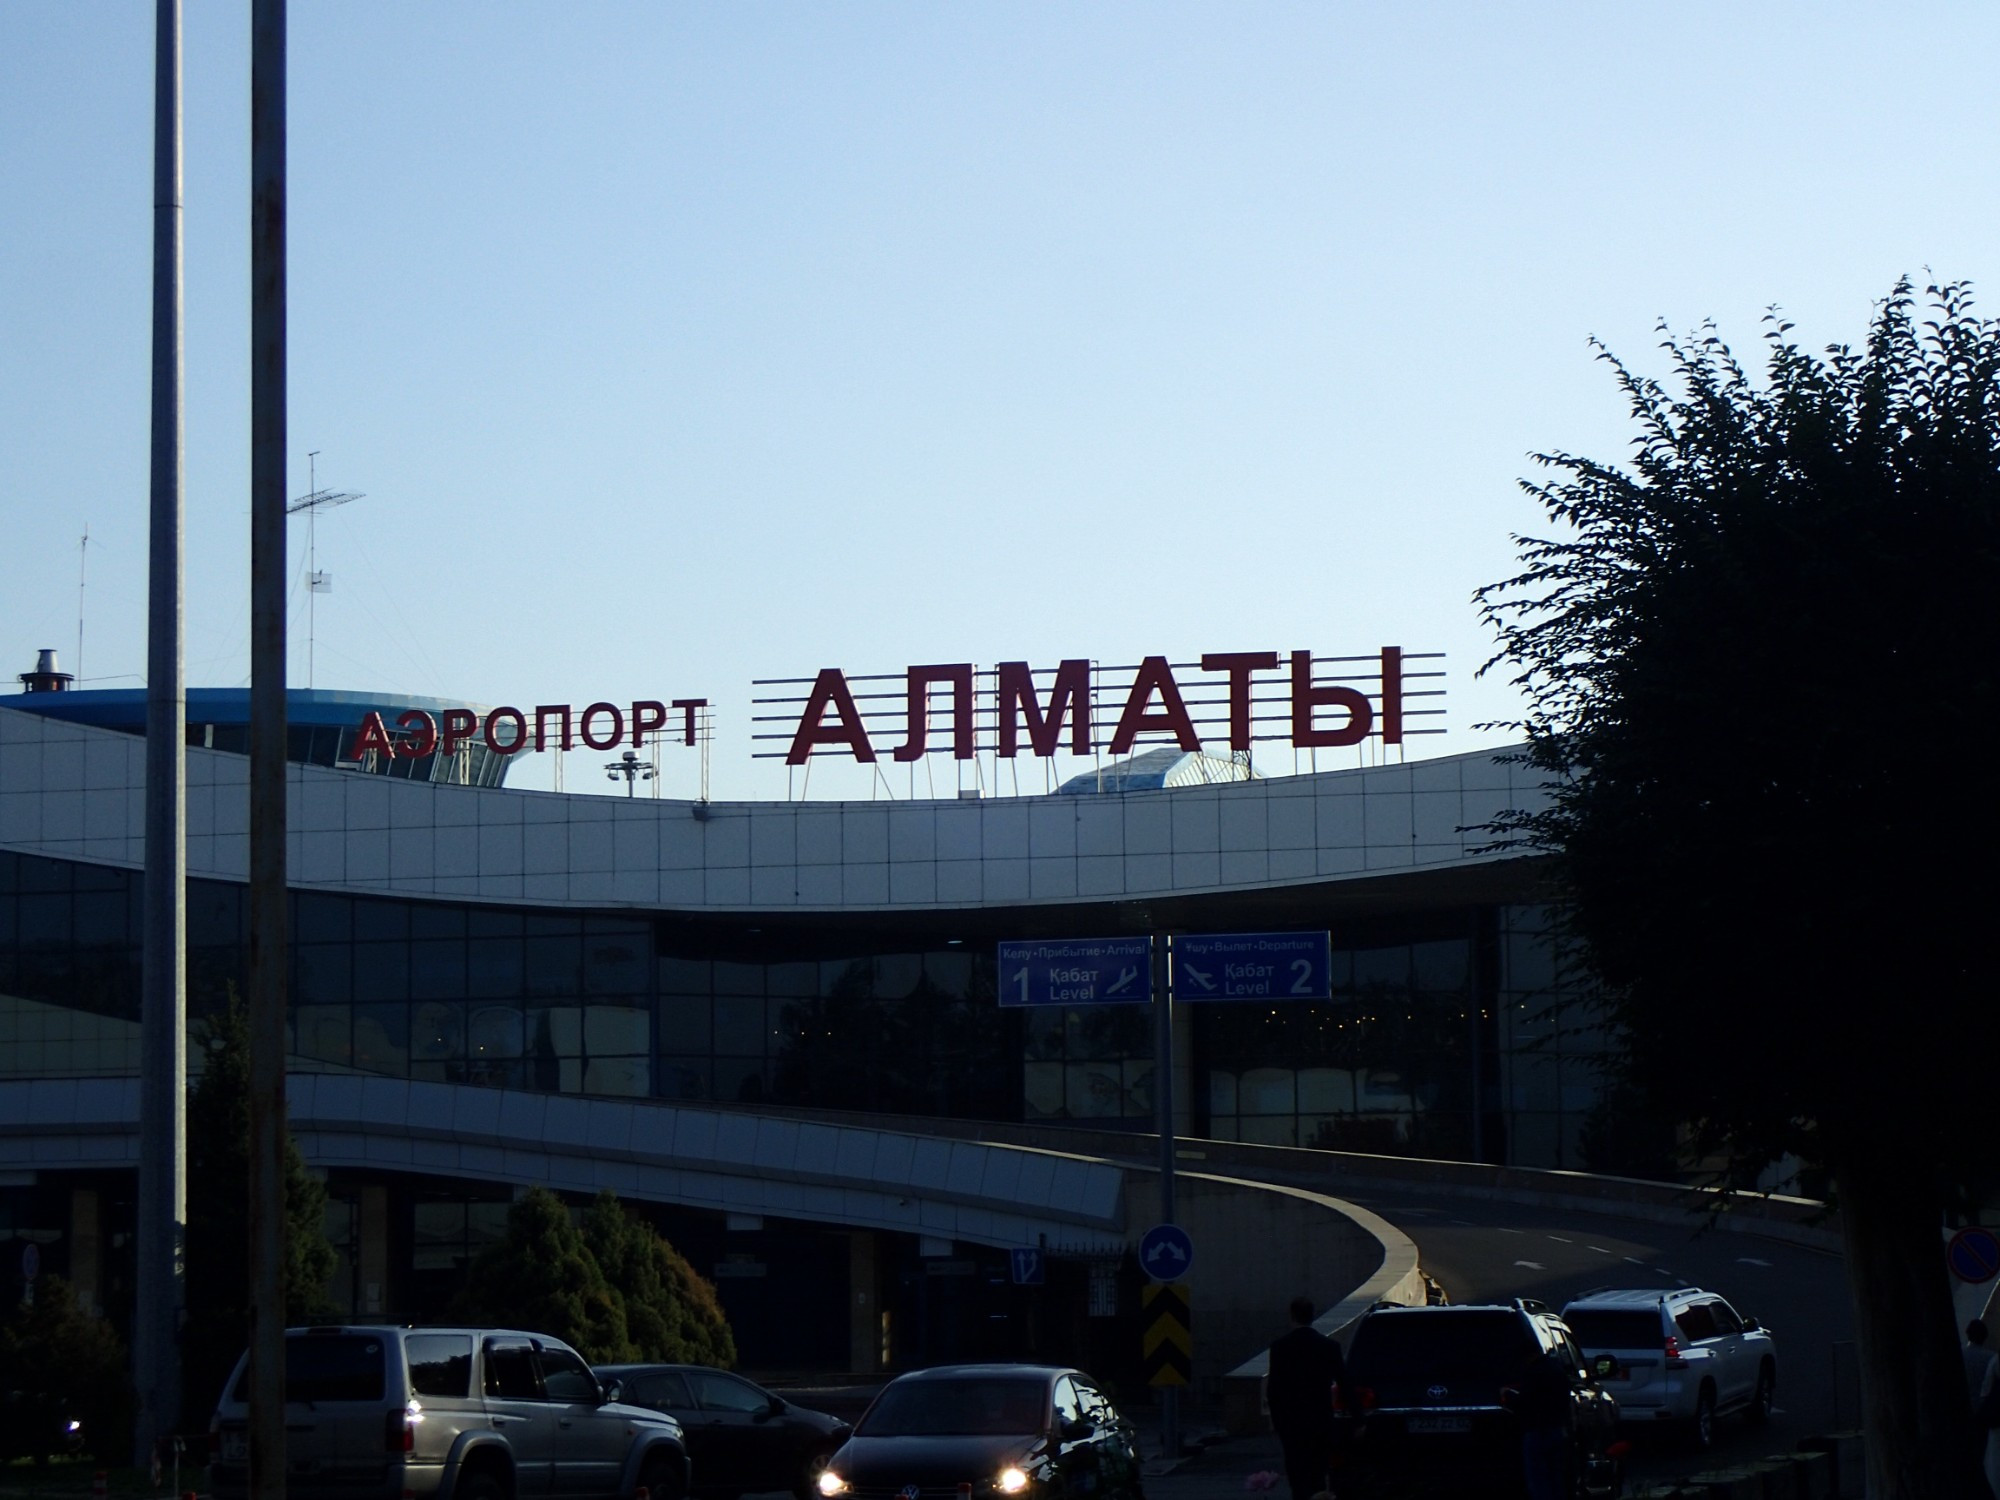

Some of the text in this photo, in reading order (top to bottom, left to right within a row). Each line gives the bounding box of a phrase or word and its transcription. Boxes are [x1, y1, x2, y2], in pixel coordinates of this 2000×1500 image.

[786, 646, 1402, 765] АЛМАТЫ
[353, 699, 708, 760] АЭРОПОРТ
[1003, 944, 1146, 960] Келу Прибытие Arrival
[1215, 941, 1253, 952] Вылет
[1258, 940, 1315, 952] Departure
[1013, 967, 1028, 1001] 1
[1225, 979, 1270, 995] Level
[1290, 959, 1313, 994] 2
[1050, 984, 1094, 1000] Level
